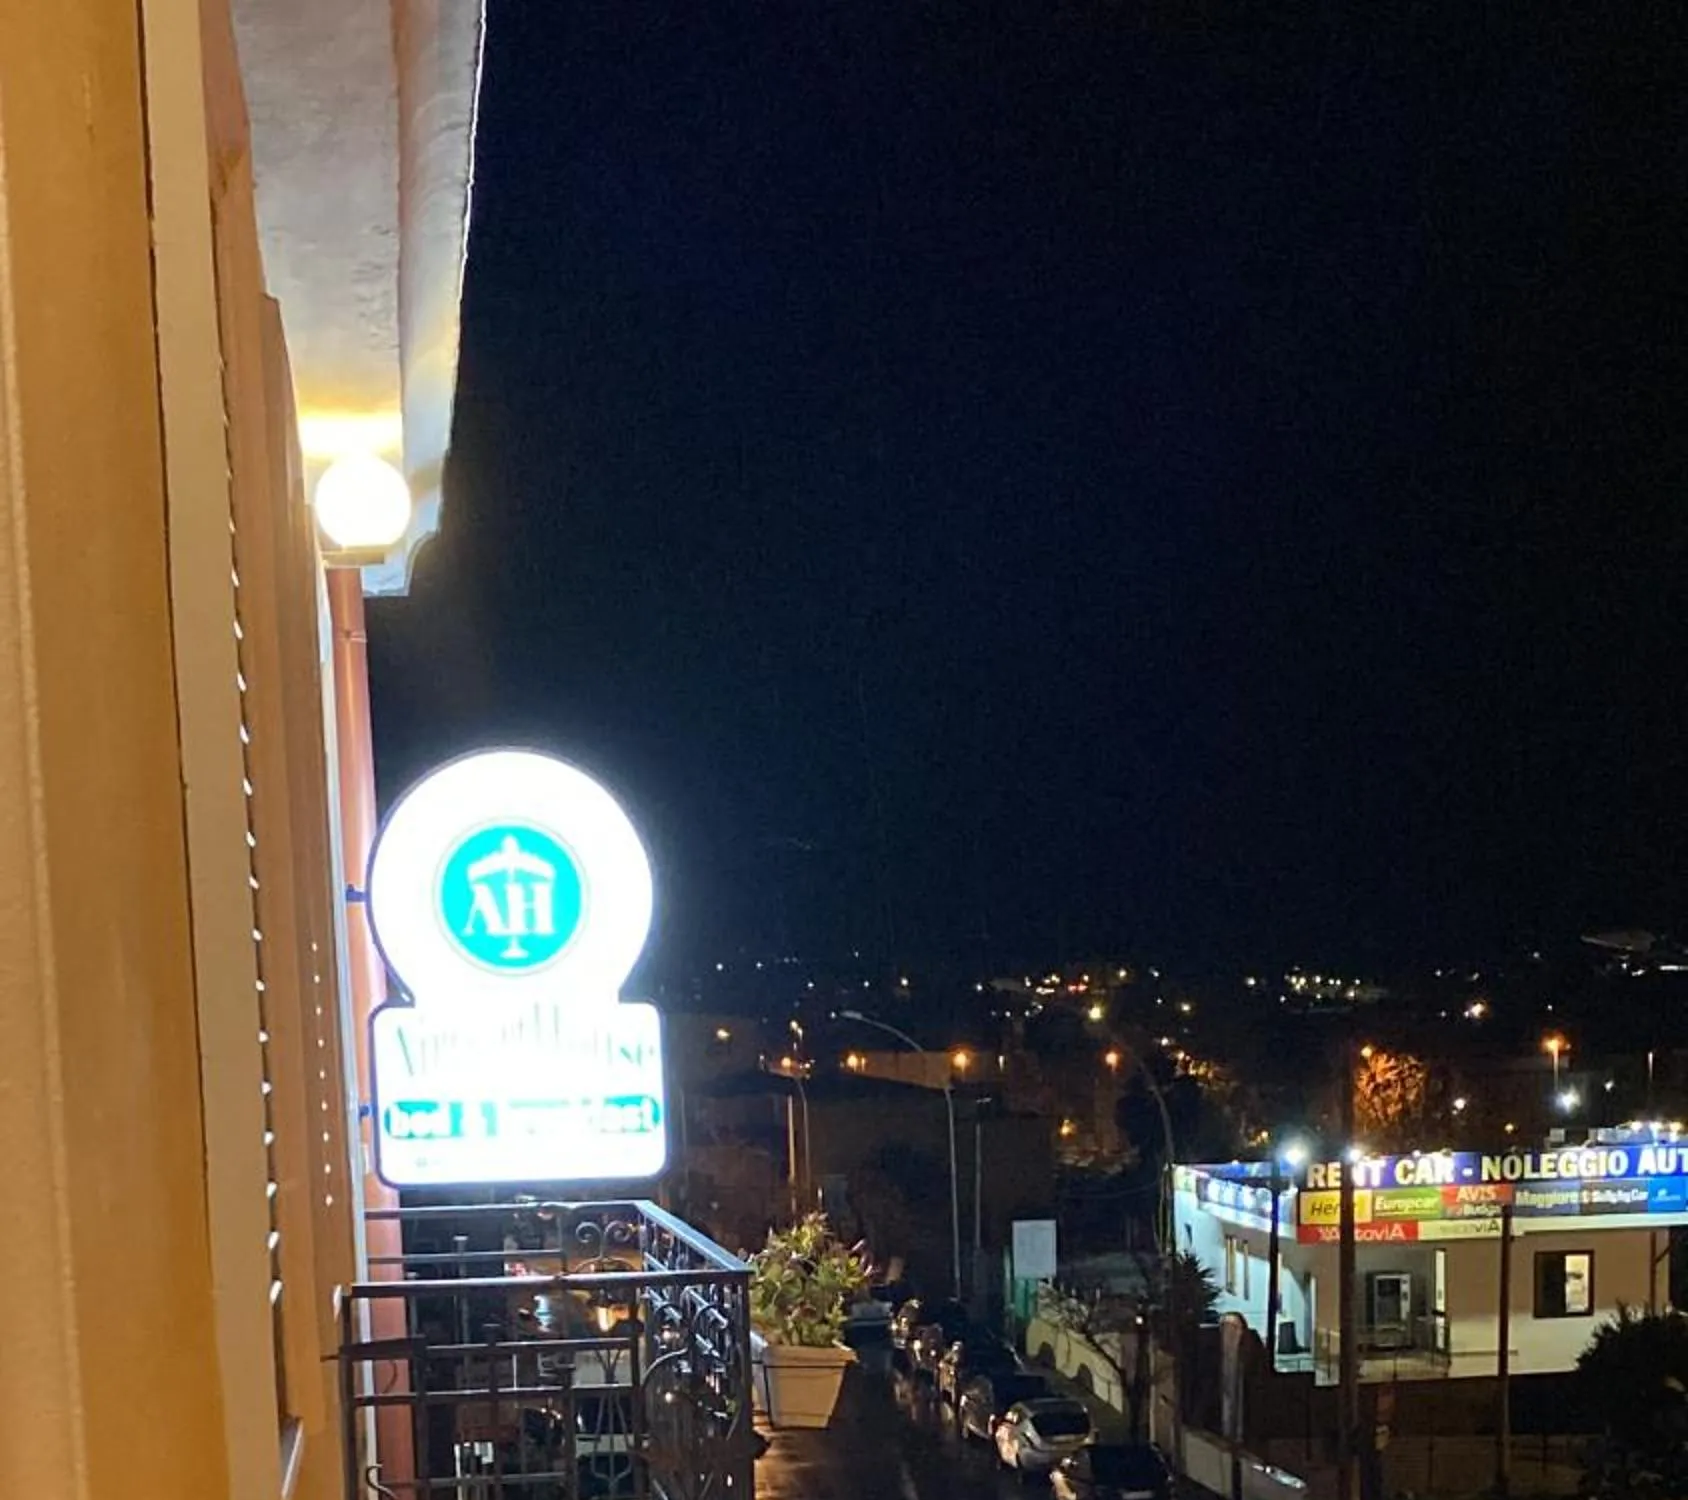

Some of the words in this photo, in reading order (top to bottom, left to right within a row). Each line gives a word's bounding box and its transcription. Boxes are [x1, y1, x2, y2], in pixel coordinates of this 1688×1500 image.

[1395, 1153, 1456, 1185] CAR
[1481, 1150, 1629, 1182] NOLEGGIO
[1456, 1184, 1498, 1203] AVIS
